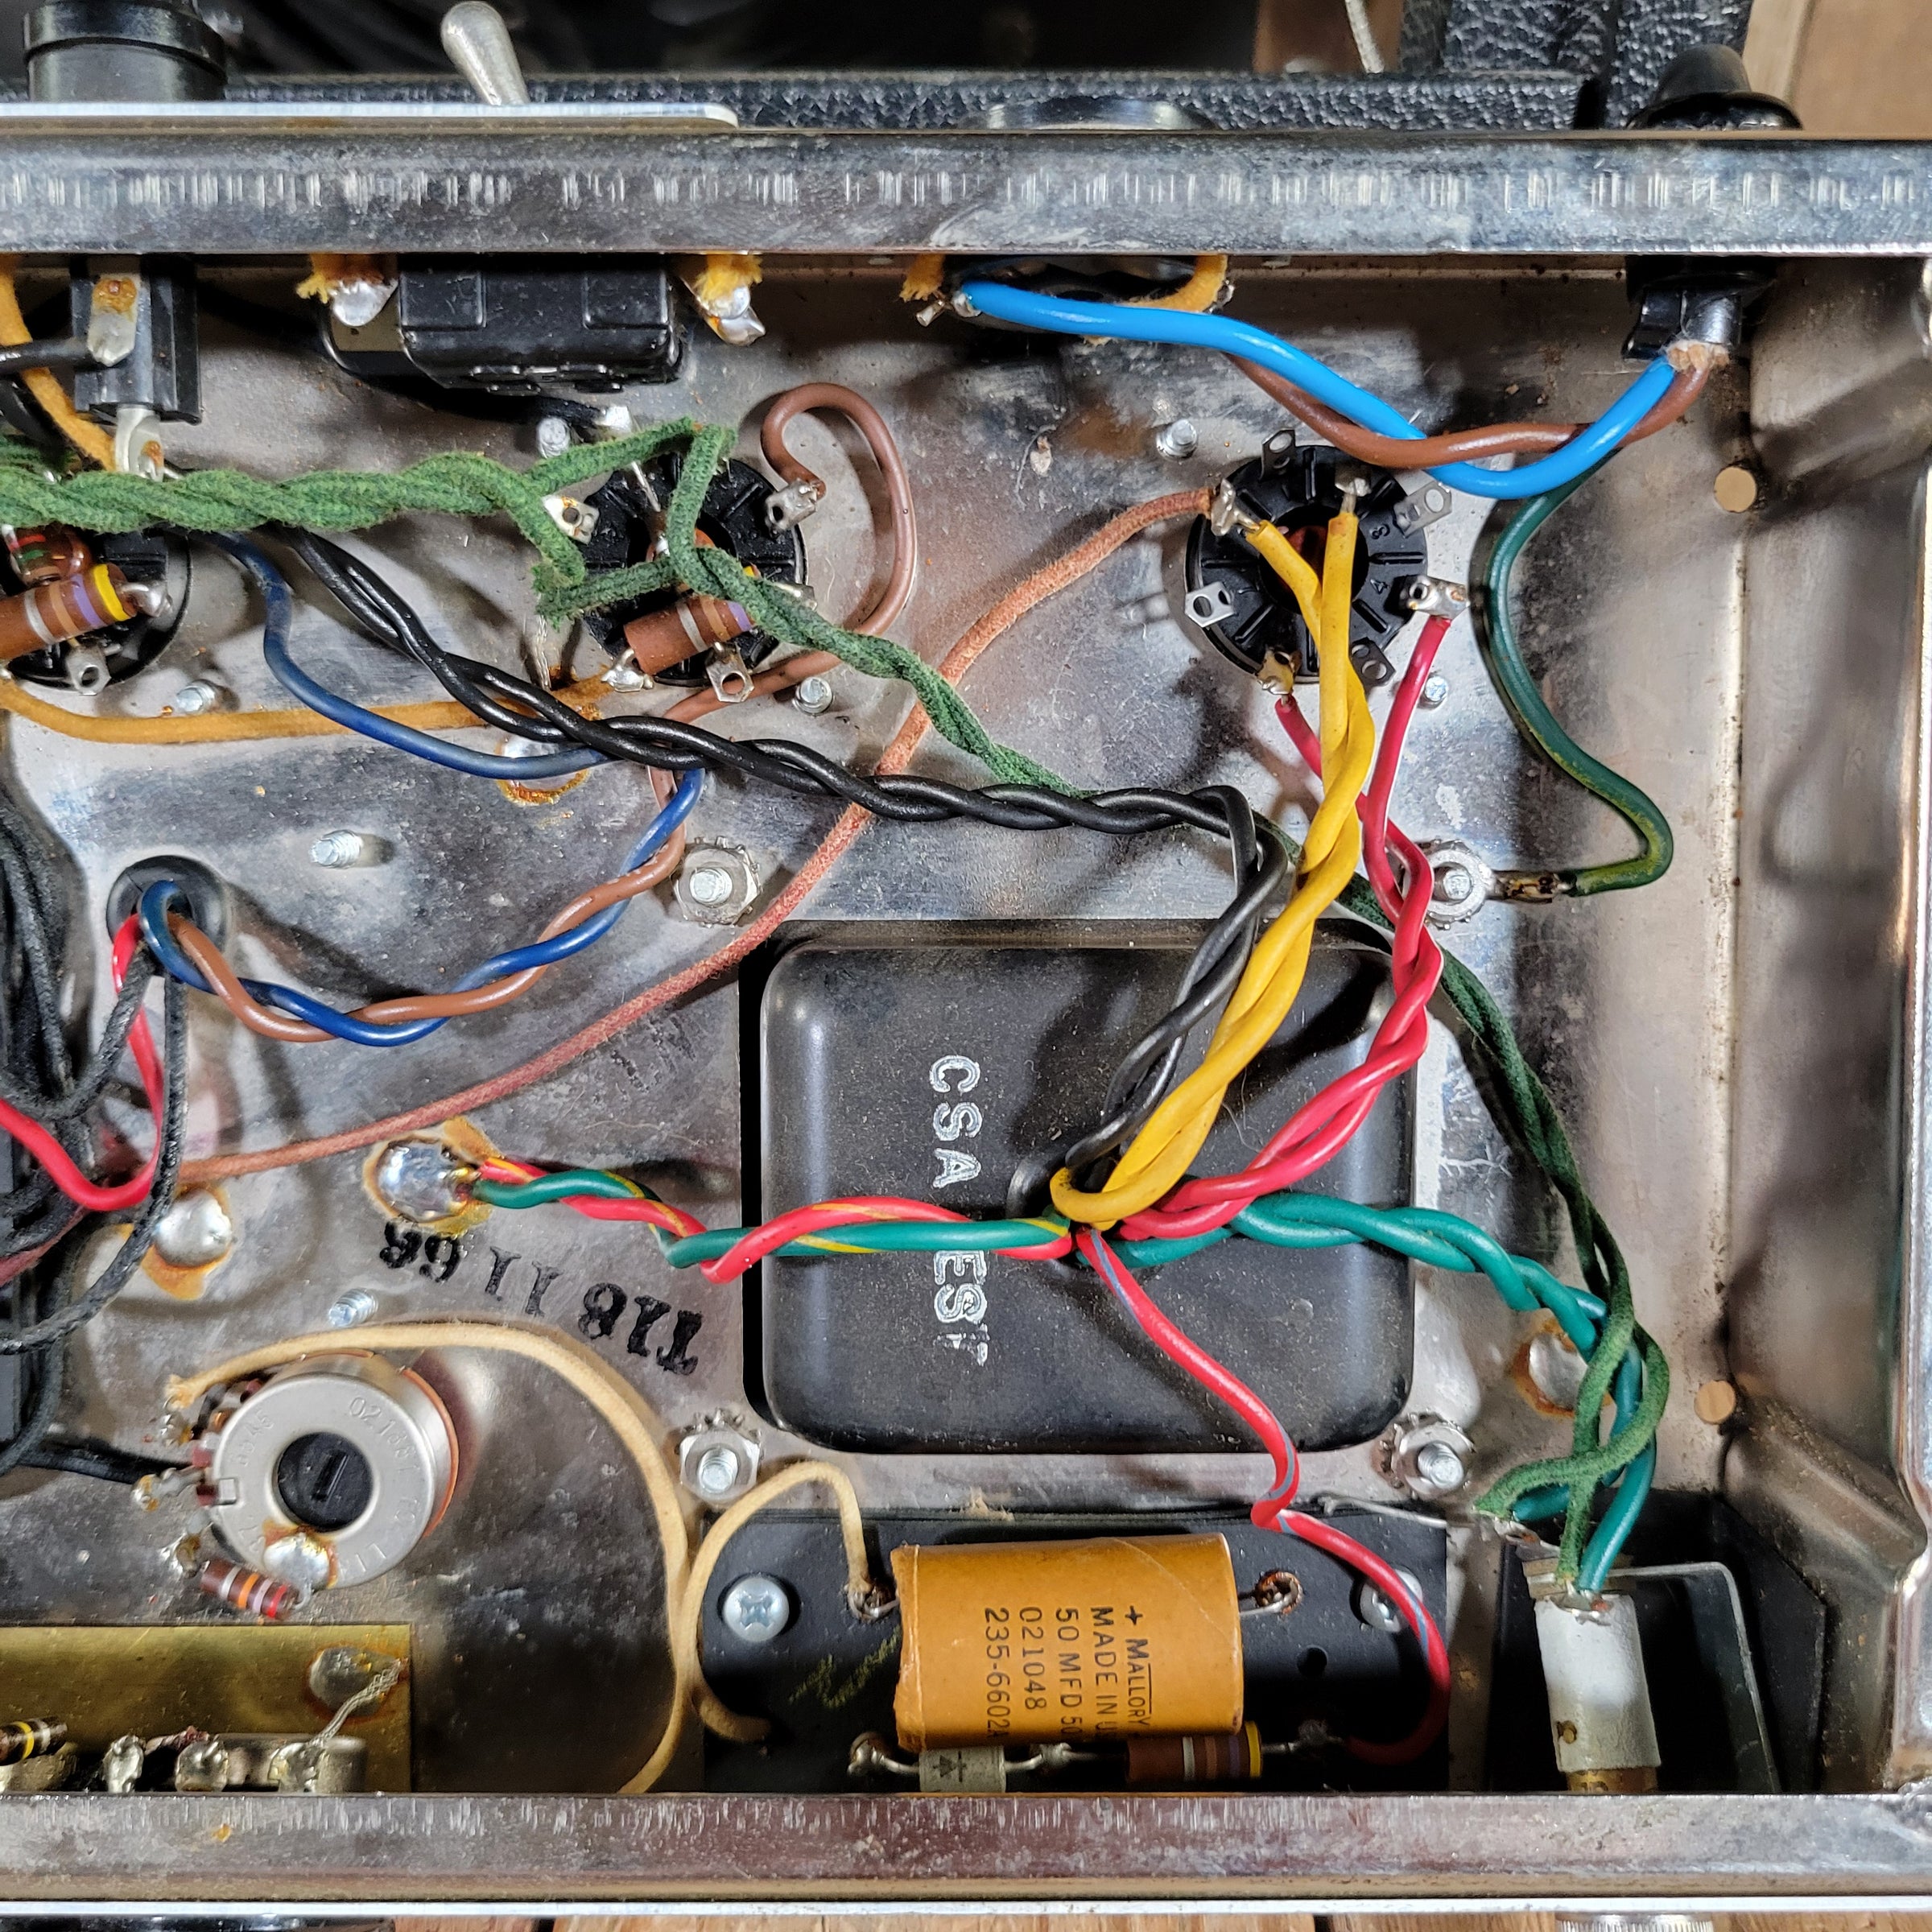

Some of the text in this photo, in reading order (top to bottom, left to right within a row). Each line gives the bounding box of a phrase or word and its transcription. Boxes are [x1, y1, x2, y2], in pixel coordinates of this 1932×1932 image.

[929, 1054, 991, 1366] CSA EST
[484, 1245, 564, 1319] 11
[578, 1282, 703, 1376] T18
[1018, 1606, 1046, 1711] 021048
[1055, 1607, 1080, 1641] 50
[1090, 1606, 1118, 1686] MADE
[1058, 1652, 1083, 1708] MFD
[1095, 1695, 1118, 1715] IN
[1125, 1637, 1153, 1727] MALLORY
